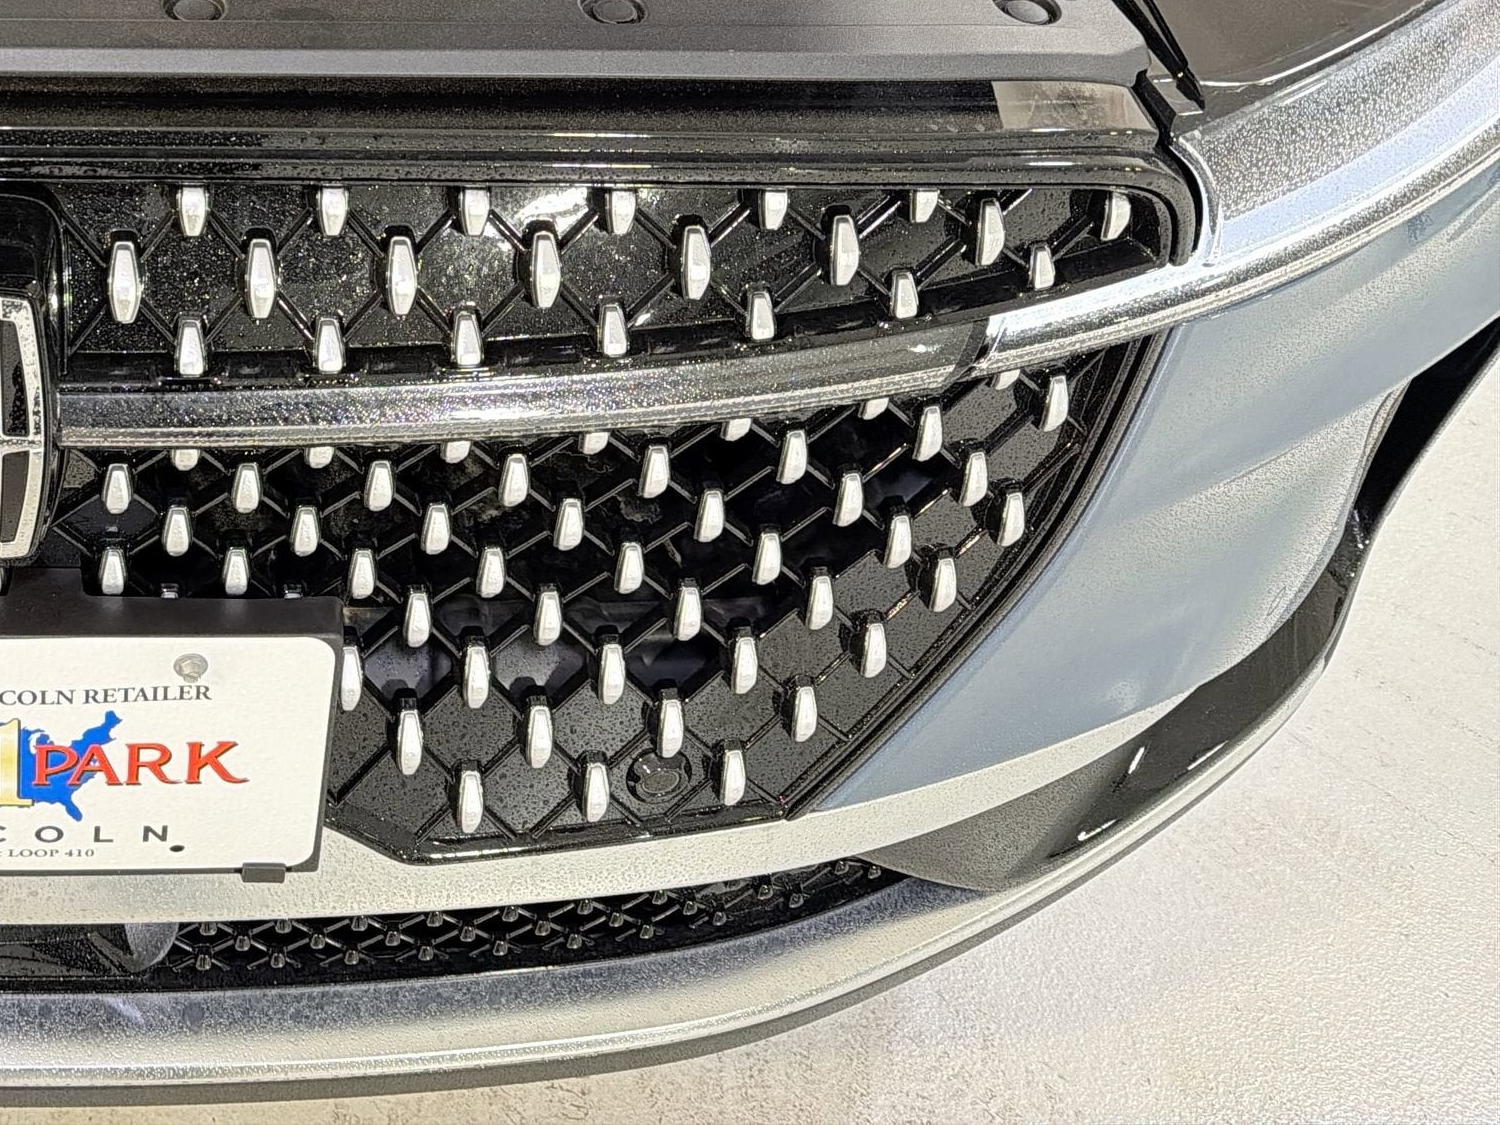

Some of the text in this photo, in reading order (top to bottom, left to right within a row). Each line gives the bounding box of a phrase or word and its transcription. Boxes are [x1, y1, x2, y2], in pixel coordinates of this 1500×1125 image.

[84, 683, 212, 704] RETAILER
[33, 741, 250, 787] PARK
[7, 845, 60, 858] LOOP
[64, 845, 96, 858] 410
